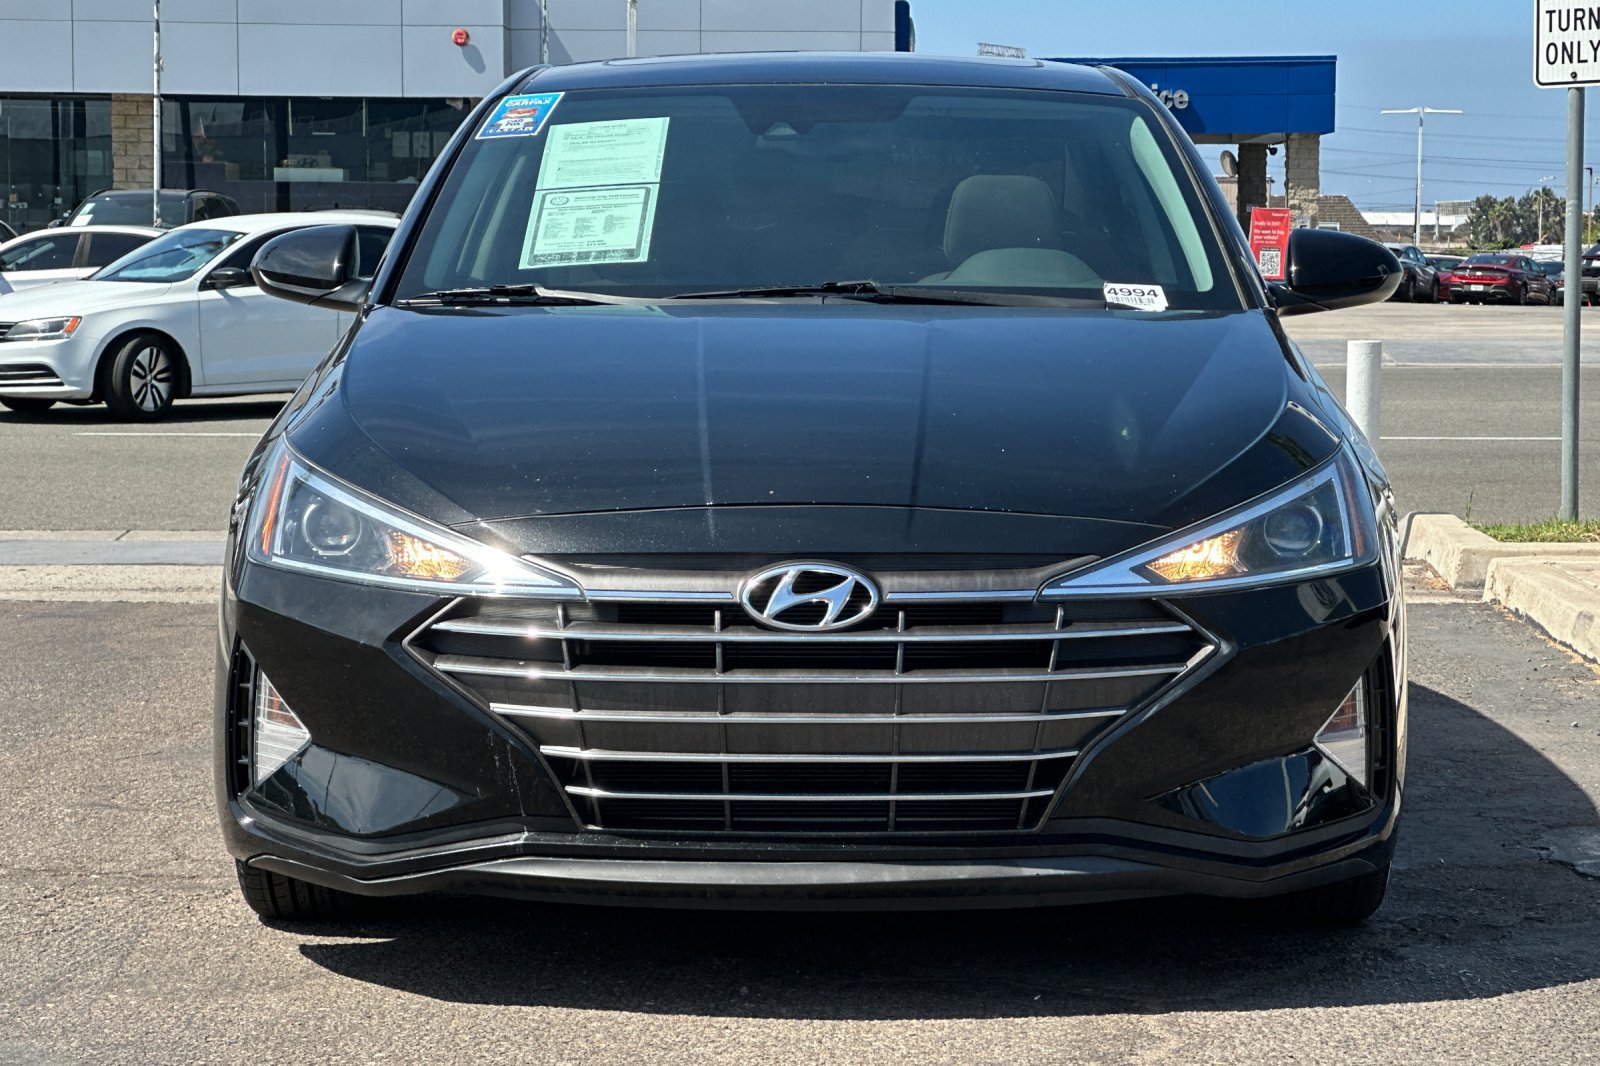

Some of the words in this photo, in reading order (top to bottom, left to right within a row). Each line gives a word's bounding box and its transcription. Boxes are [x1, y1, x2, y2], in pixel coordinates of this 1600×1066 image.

[1545, 6, 1600, 33] TURN
[1545, 39, 1600, 65] ONLY
[505, 99, 551, 107] CARFAX
[1107, 287, 1159, 298] 4994
